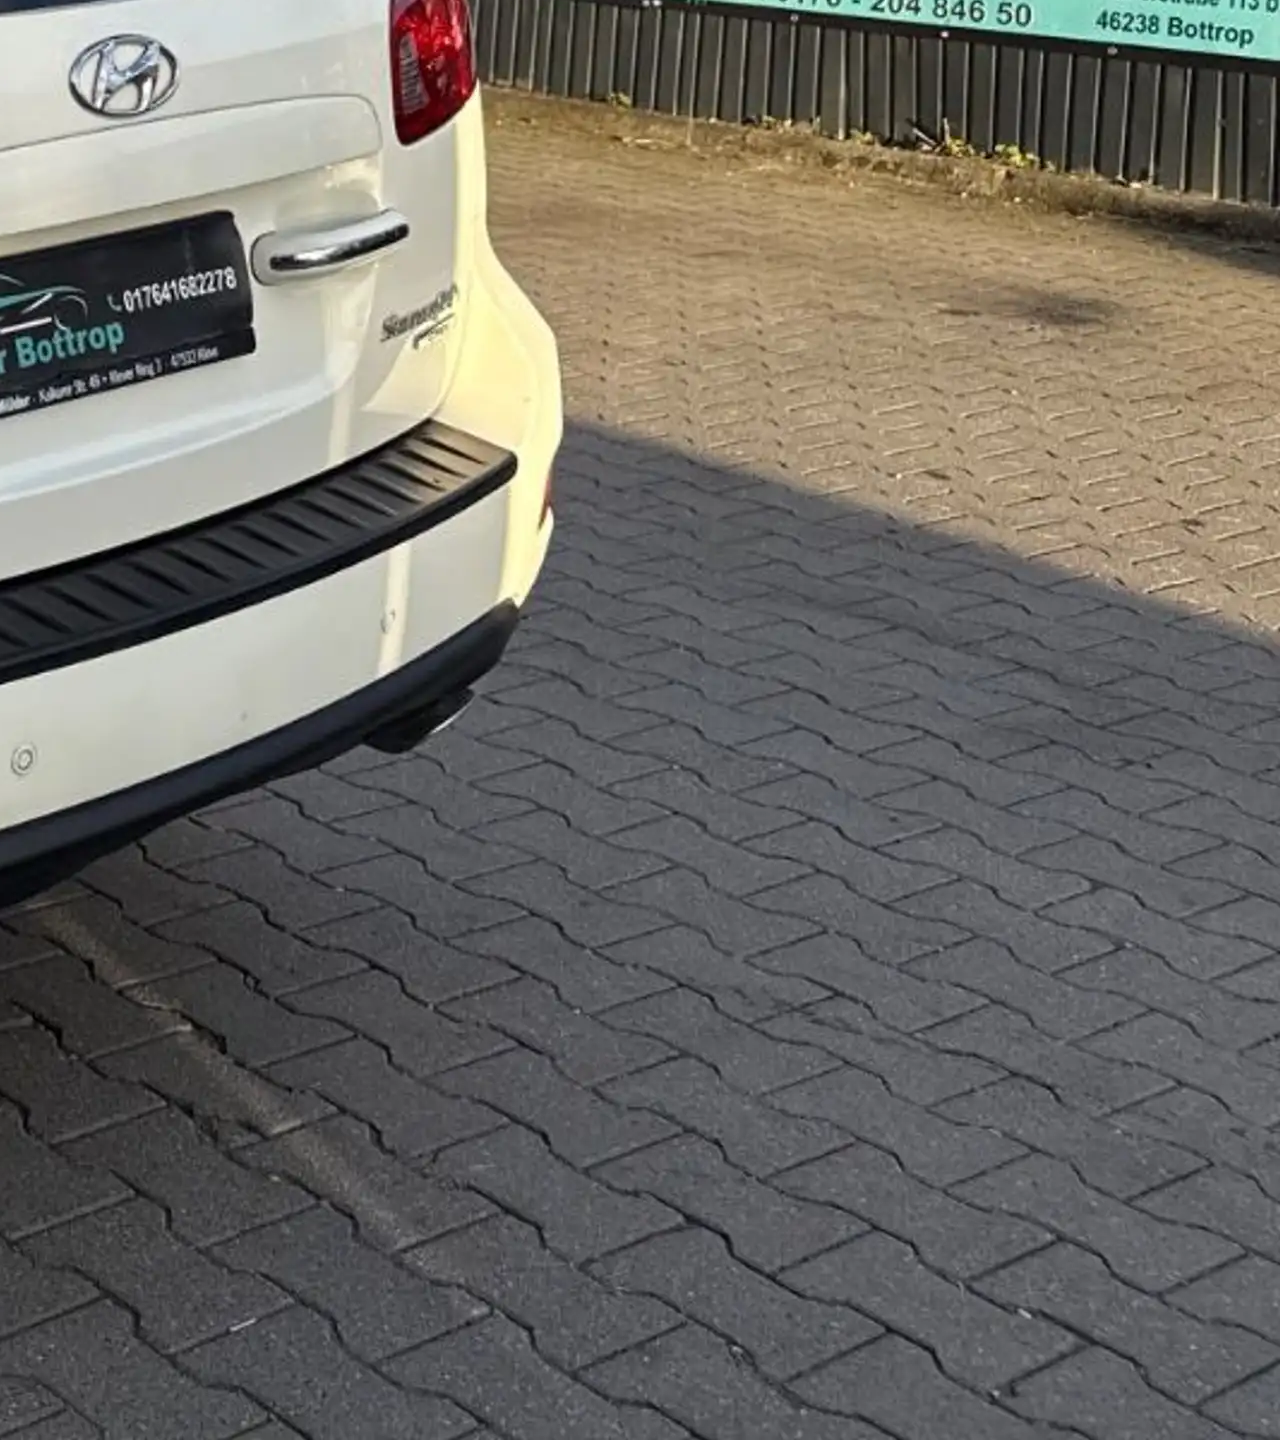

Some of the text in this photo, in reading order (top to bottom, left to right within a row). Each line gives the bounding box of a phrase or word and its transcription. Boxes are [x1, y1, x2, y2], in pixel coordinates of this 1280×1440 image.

[996, 2, 1032, 27] 50
[1096, 10, 1254, 48] 46238 Bottrop
[15, 321, 125, 368] Bottrop
